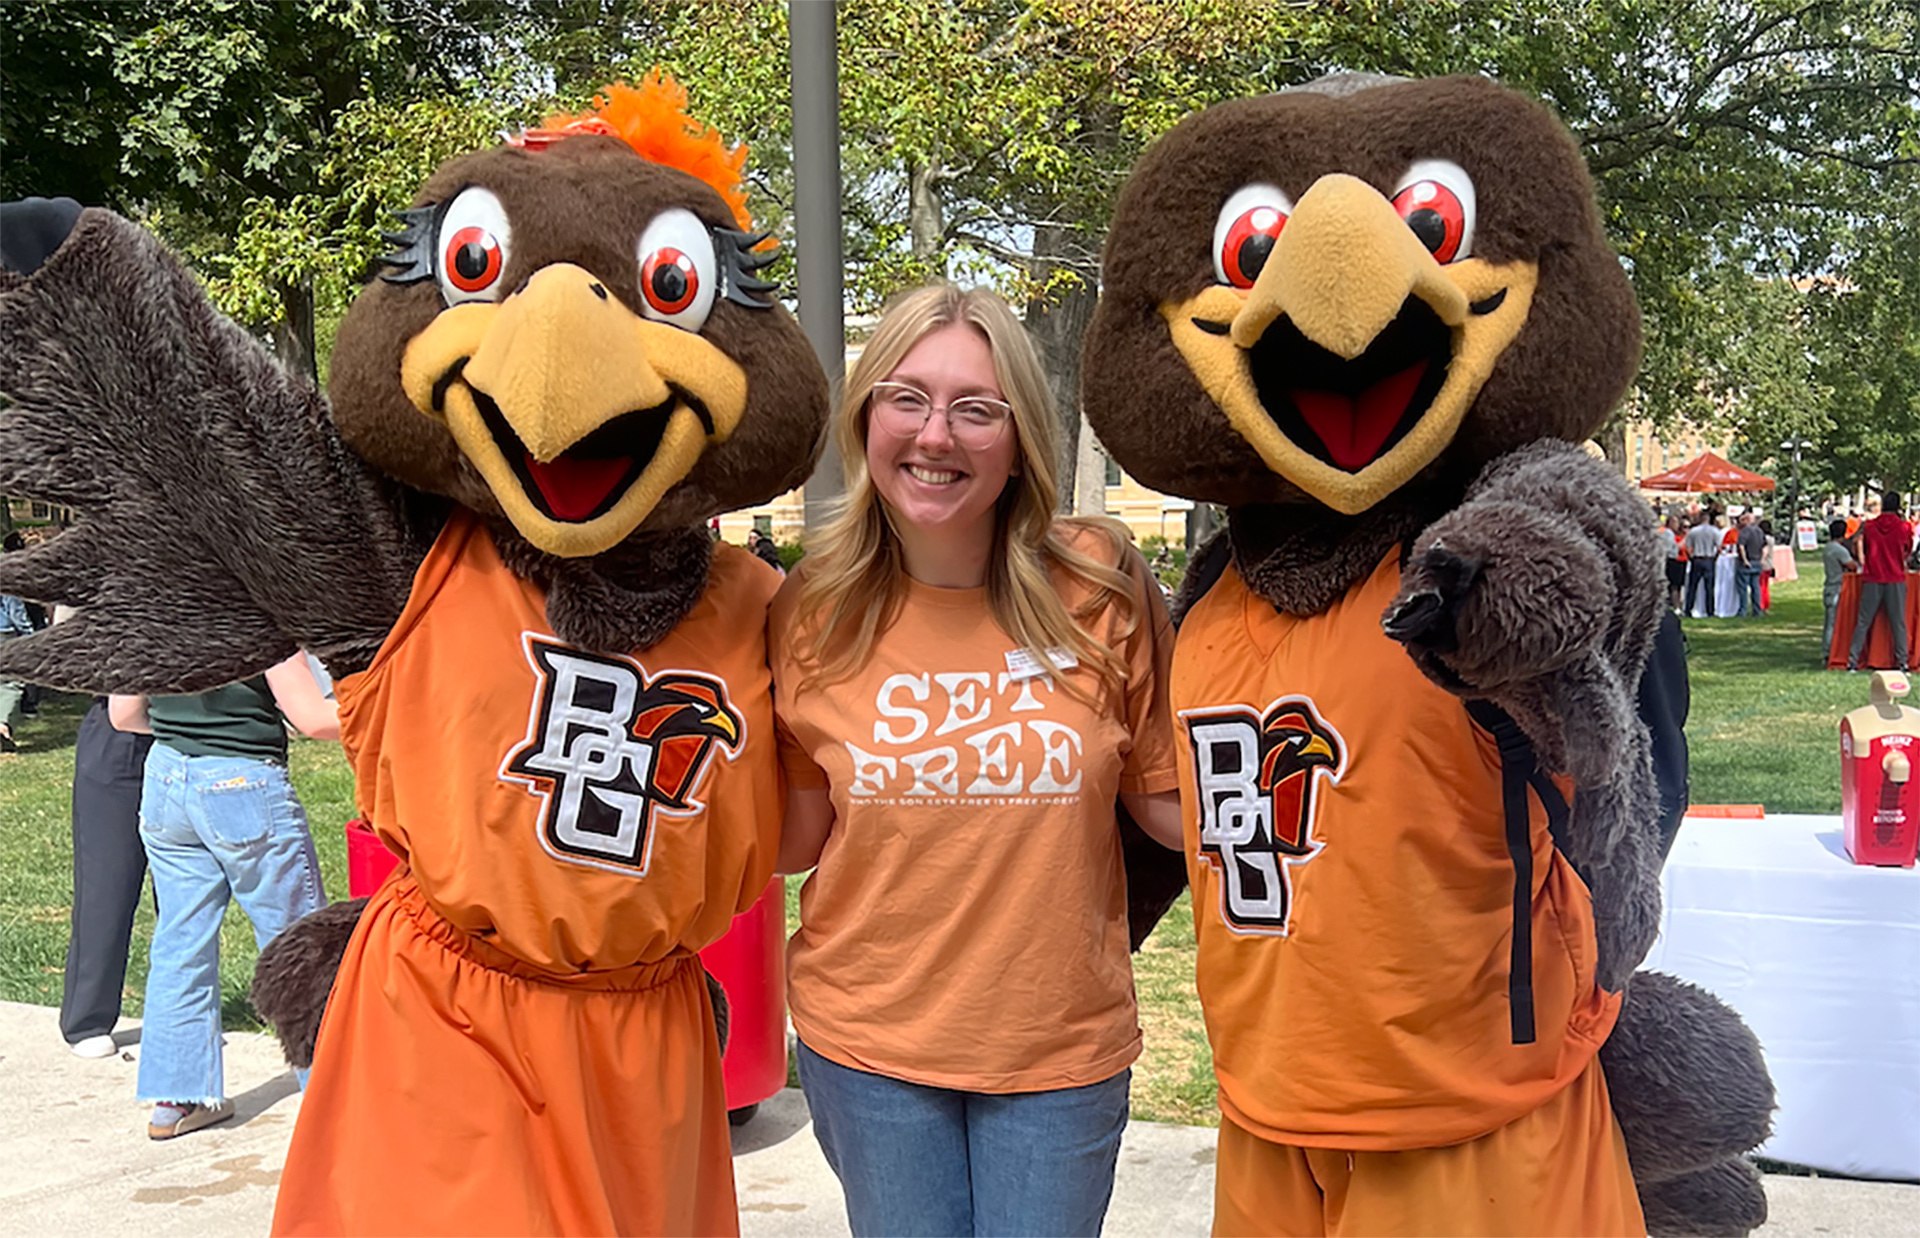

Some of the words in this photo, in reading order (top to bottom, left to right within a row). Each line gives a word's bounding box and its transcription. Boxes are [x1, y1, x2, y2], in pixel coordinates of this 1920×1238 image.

[873, 671, 1054, 745] SET
[844, 720, 1083, 796] FREE
[1880, 735, 1913, 747] HEINZ
[873, 797, 896, 806] THE
[899, 798, 924, 807] SON
[960, 798, 991, 806] FREE
[1008, 798, 1038, 806] FREE
